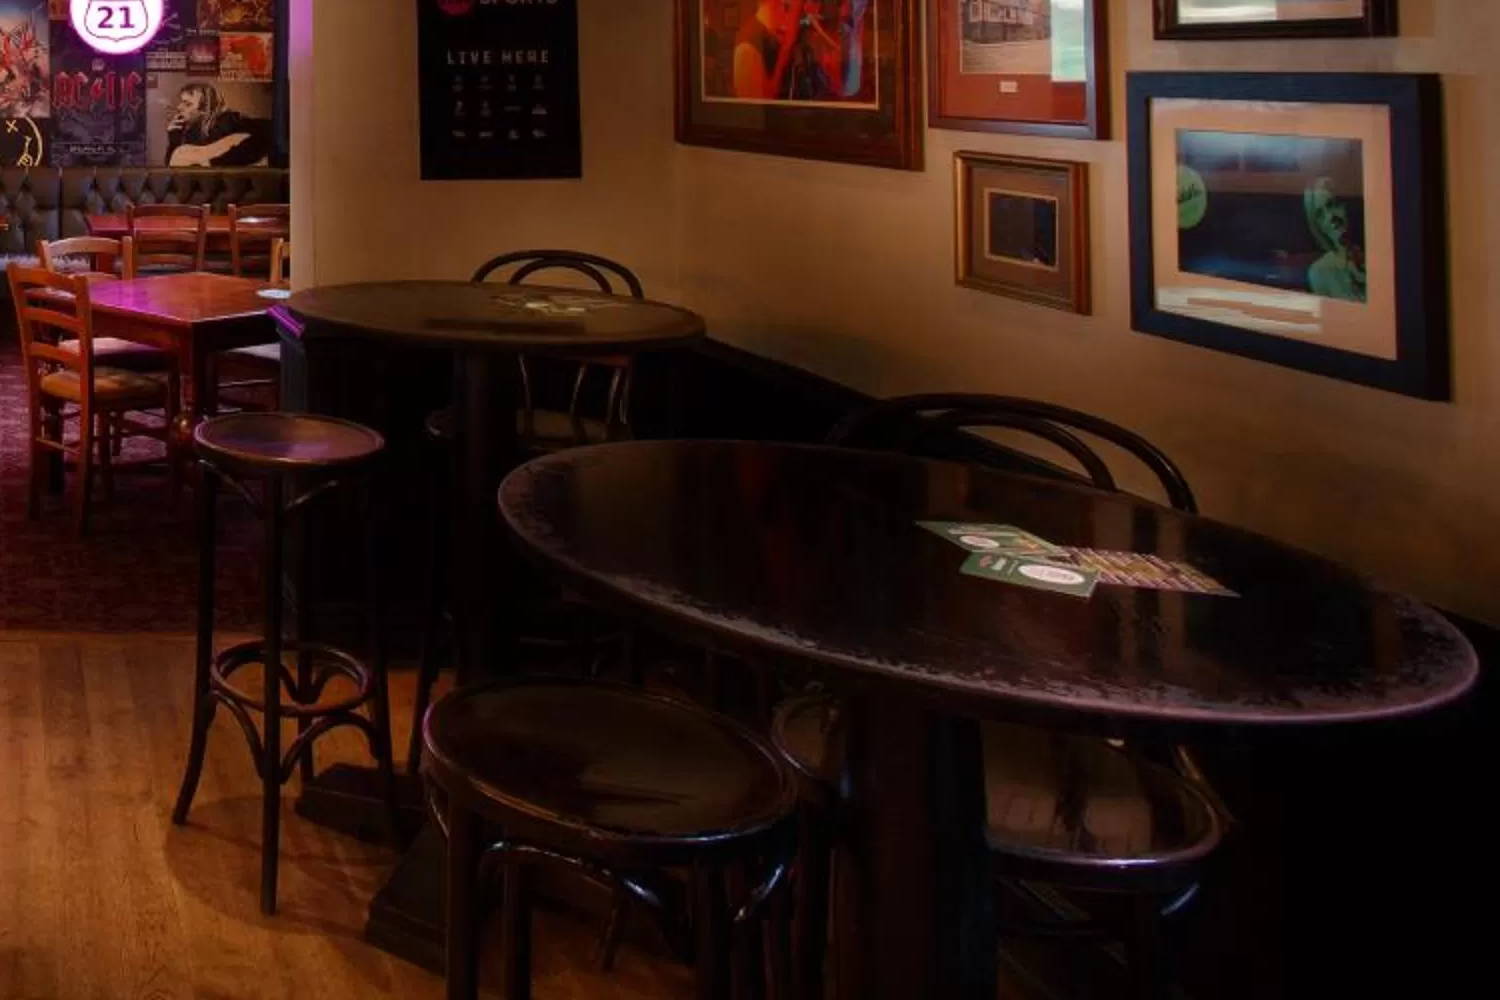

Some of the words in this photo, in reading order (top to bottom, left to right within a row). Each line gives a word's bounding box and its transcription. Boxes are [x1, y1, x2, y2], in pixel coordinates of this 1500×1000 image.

[97, 6, 135, 29] 21
[446, 50, 493, 66] LIVE
[501, 49, 550, 65] HERE
